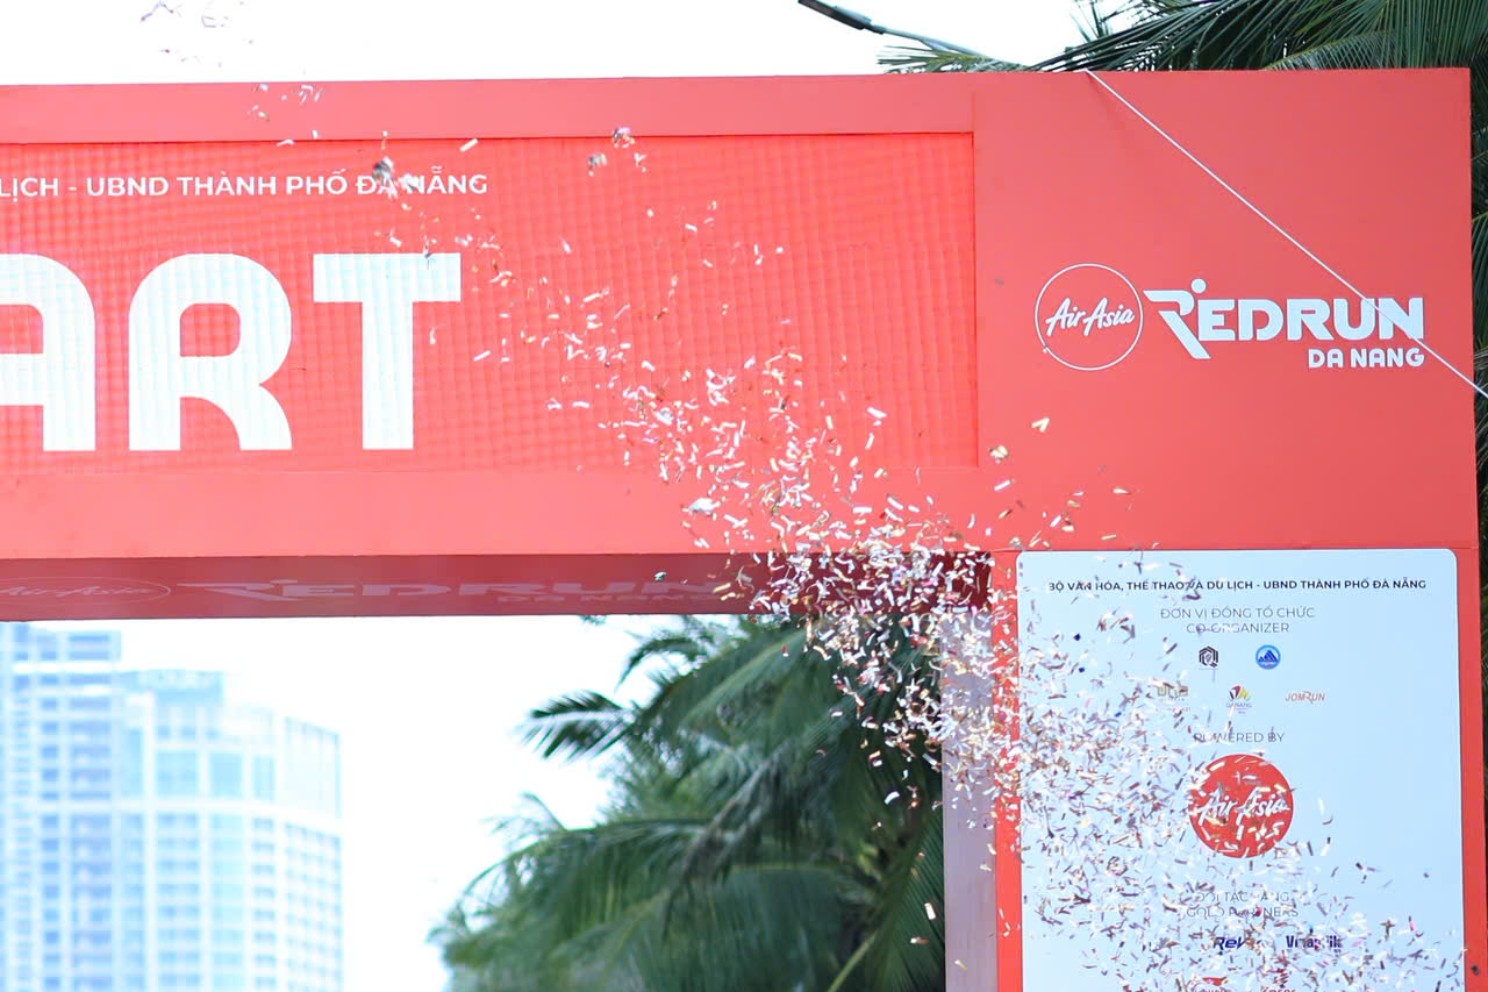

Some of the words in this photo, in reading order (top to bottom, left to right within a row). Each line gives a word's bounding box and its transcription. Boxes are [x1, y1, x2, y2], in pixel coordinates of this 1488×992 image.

[86, 176, 169, 197] UBND
[177, 170, 277, 196] THÀNH
[286, 169, 348, 196] PHỐ
[1143, 285, 1424, 359] REDRUN
[1308, 348, 1344, 369] DA
[1350, 347, 1425, 369] NANG
[1152, 581, 1184, 590] THAO
[1207, 581, 1224, 590] DU
[1227, 581, 1253, 592] LỊCH
[1264, 580, 1297, 589] UBND
[1300, 578, 1341, 589] THÀNH
[1373, 577, 1390, 588] ĐÀ
